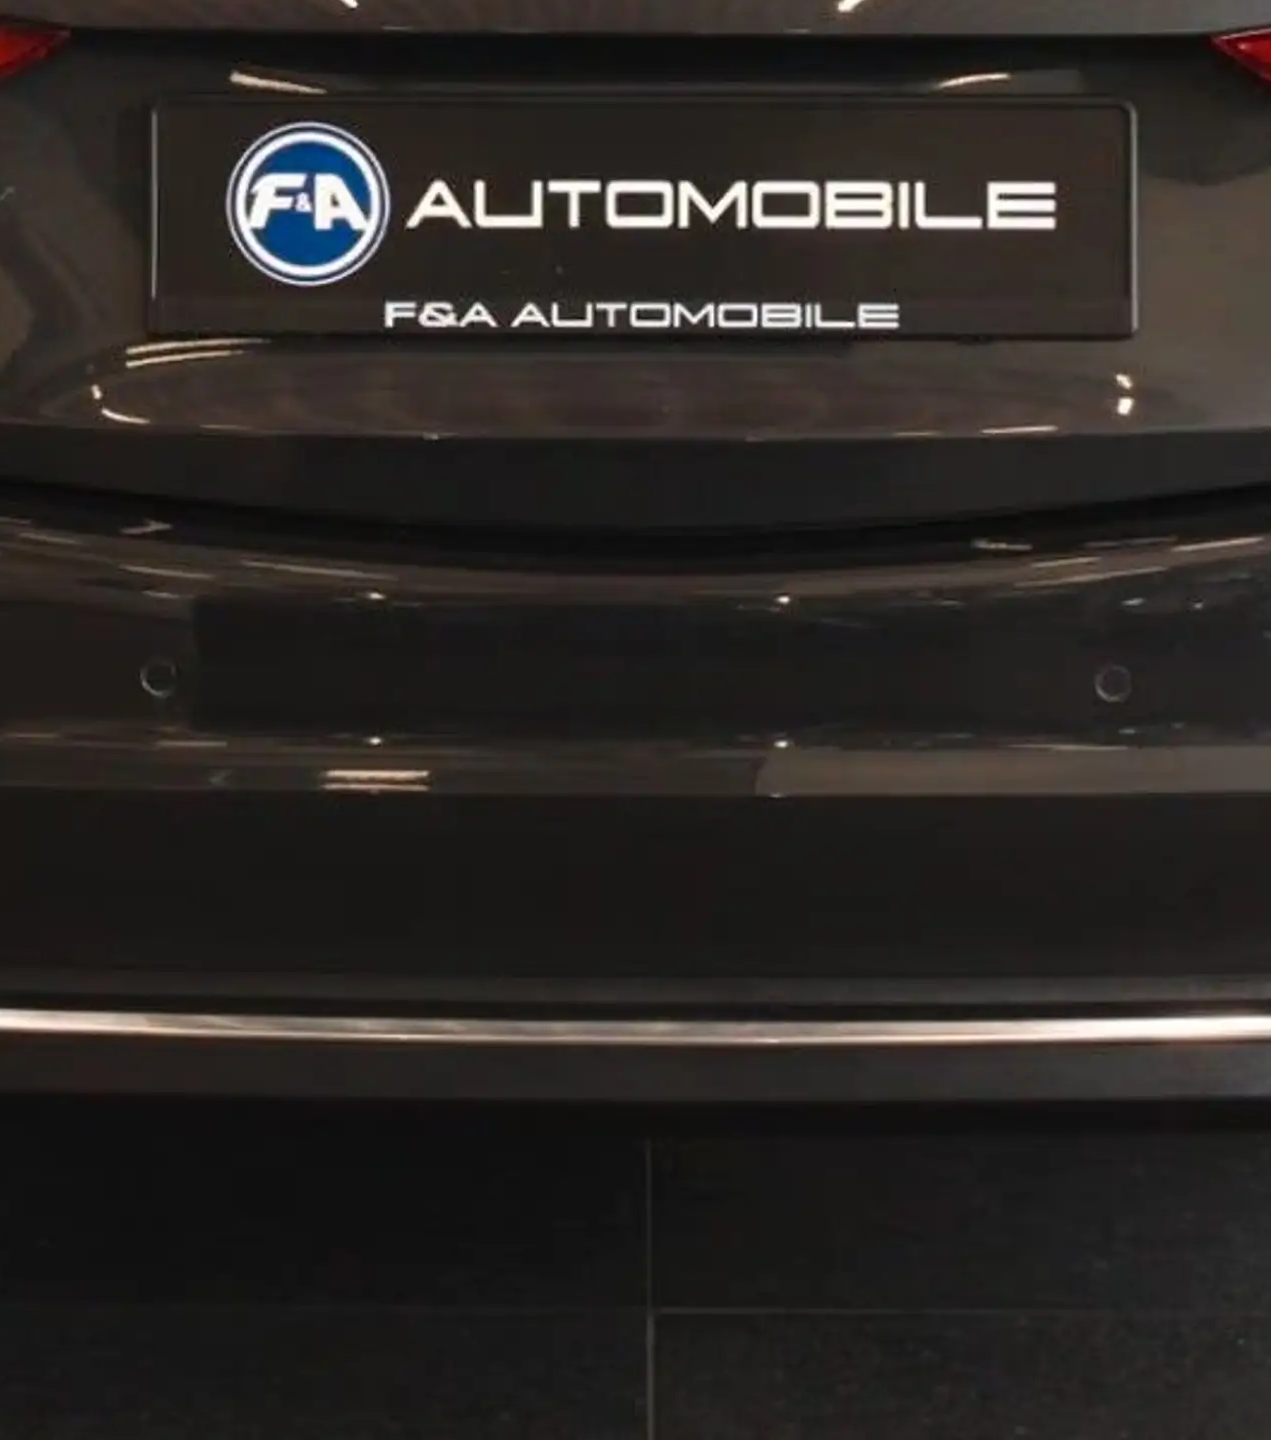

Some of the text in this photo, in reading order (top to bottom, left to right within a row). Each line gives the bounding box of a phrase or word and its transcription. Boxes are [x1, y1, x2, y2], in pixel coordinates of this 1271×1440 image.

[249, 172, 1057, 231] F&A AUTOMOBILE
[383, 300, 900, 329] F&A AUTOMOBILE
